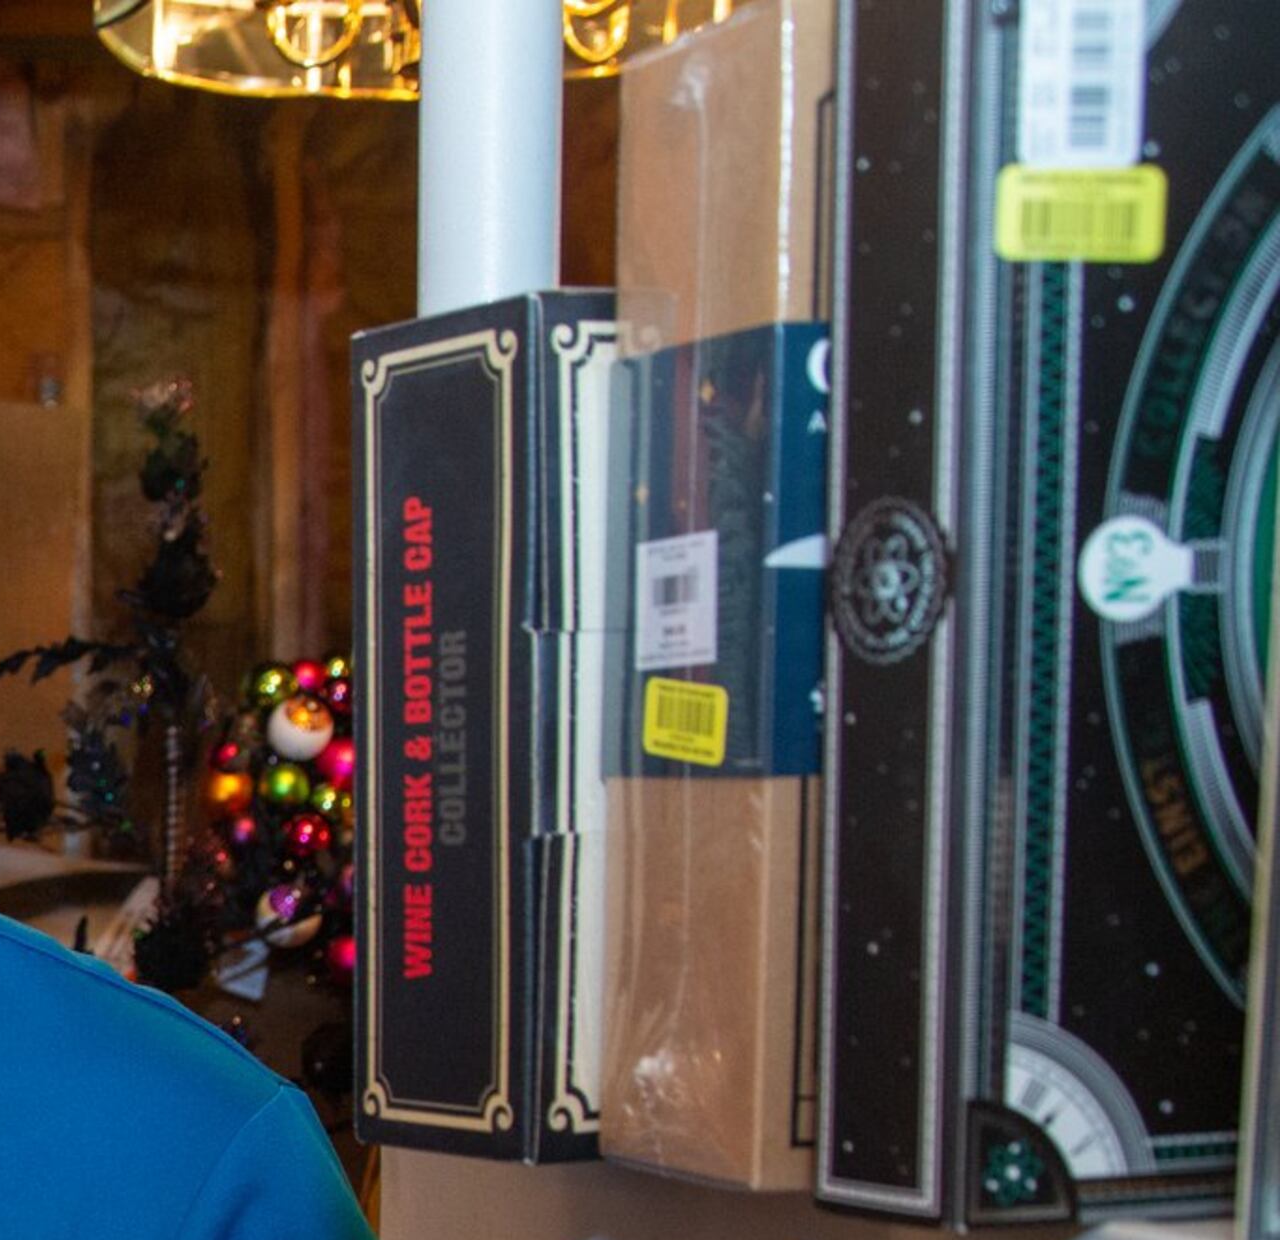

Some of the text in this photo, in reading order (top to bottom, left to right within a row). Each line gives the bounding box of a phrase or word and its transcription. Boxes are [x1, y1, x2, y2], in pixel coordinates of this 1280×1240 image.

[402, 496, 433, 979] WINE CORK & BOTTLE CAP
[440, 629, 468, 846] COLLECTOR
